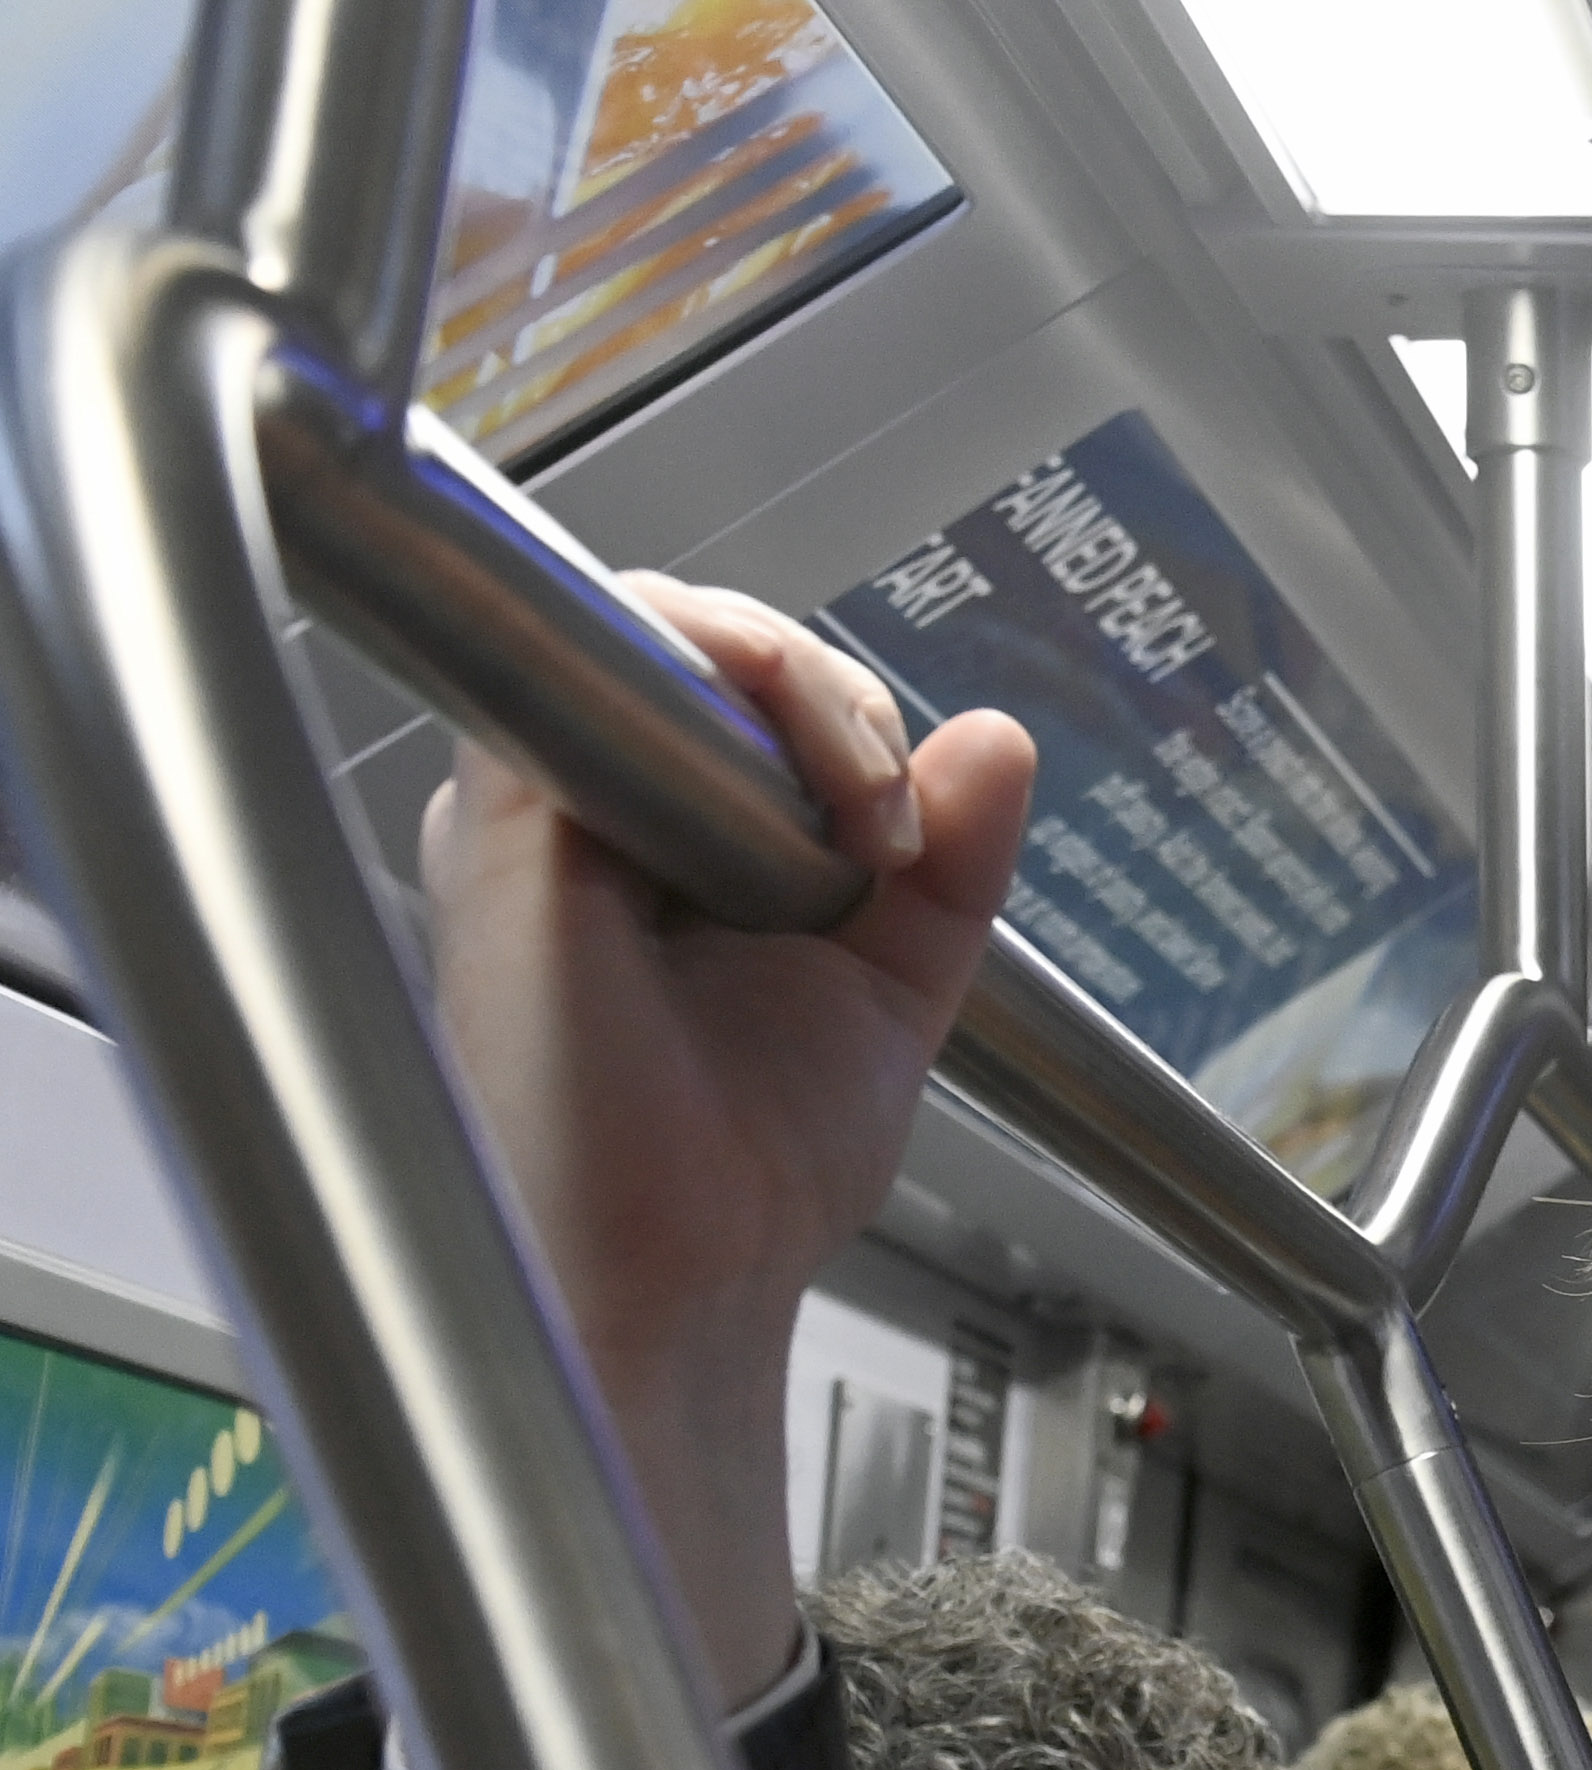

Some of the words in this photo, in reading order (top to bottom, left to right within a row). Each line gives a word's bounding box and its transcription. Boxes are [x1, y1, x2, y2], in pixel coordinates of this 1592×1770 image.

[872, 531, 994, 630] ART
[993, 453, 1139, 594] ANNED
[1084, 563, 1218, 683] PEACH
